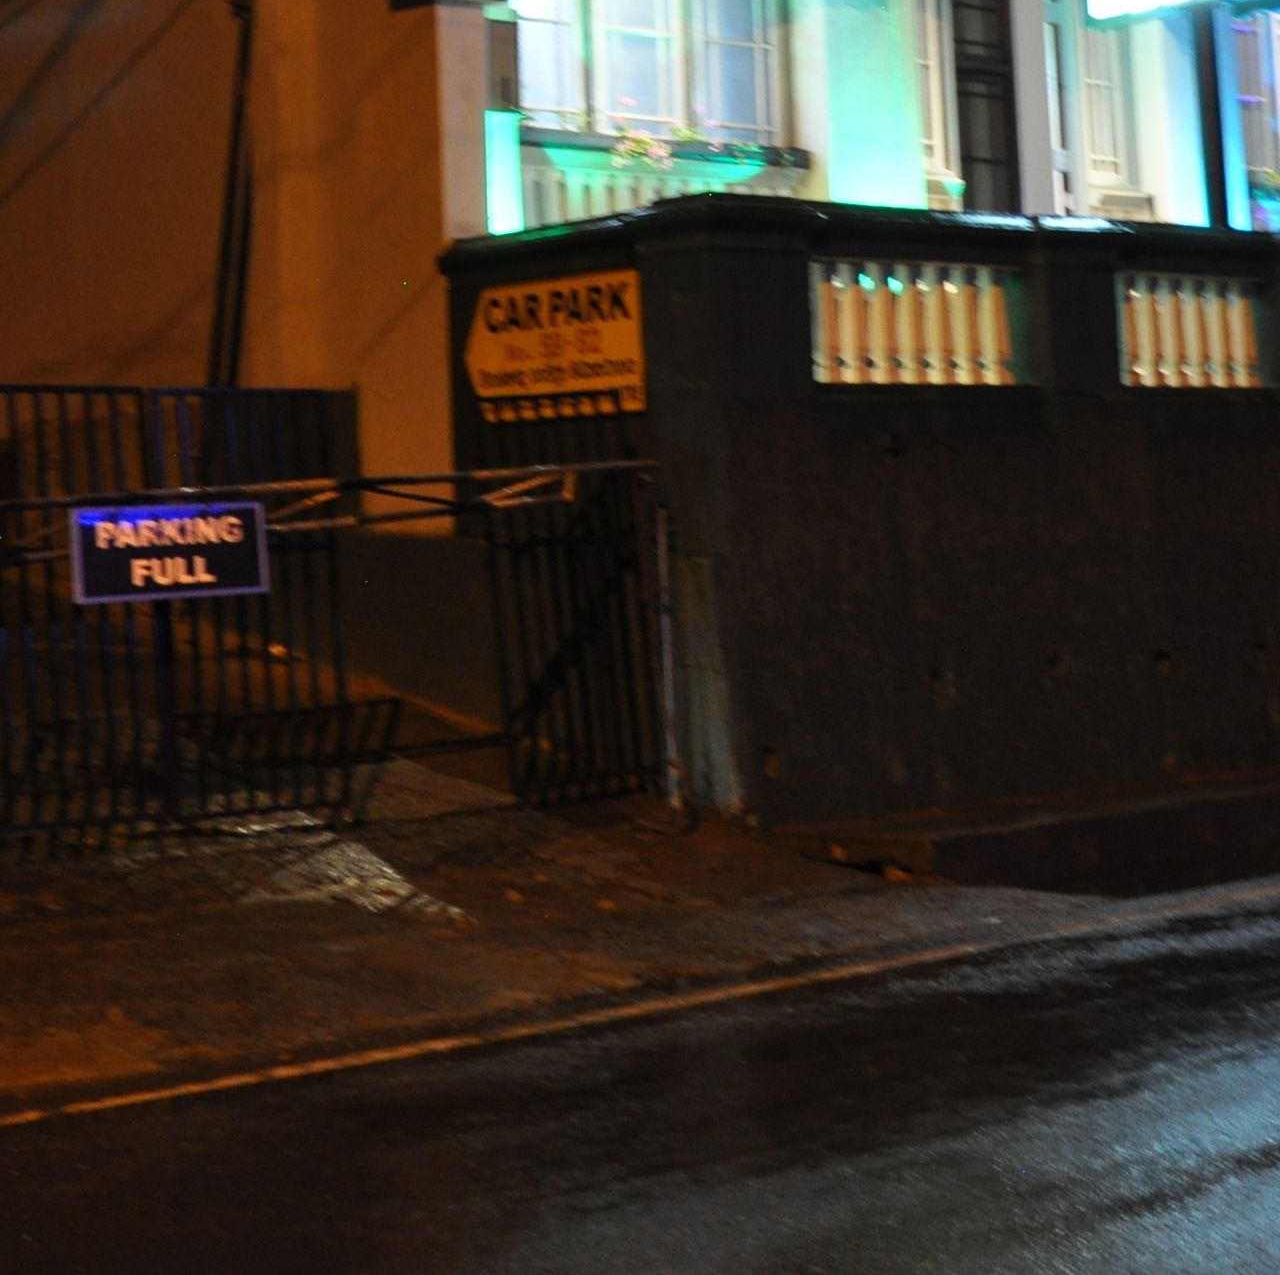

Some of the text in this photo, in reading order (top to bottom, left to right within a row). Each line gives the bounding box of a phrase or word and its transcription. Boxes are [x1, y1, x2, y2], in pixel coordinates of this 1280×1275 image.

[484, 281, 633, 335] CAR PARK
[94, 513, 247, 588] PARKING FULL
